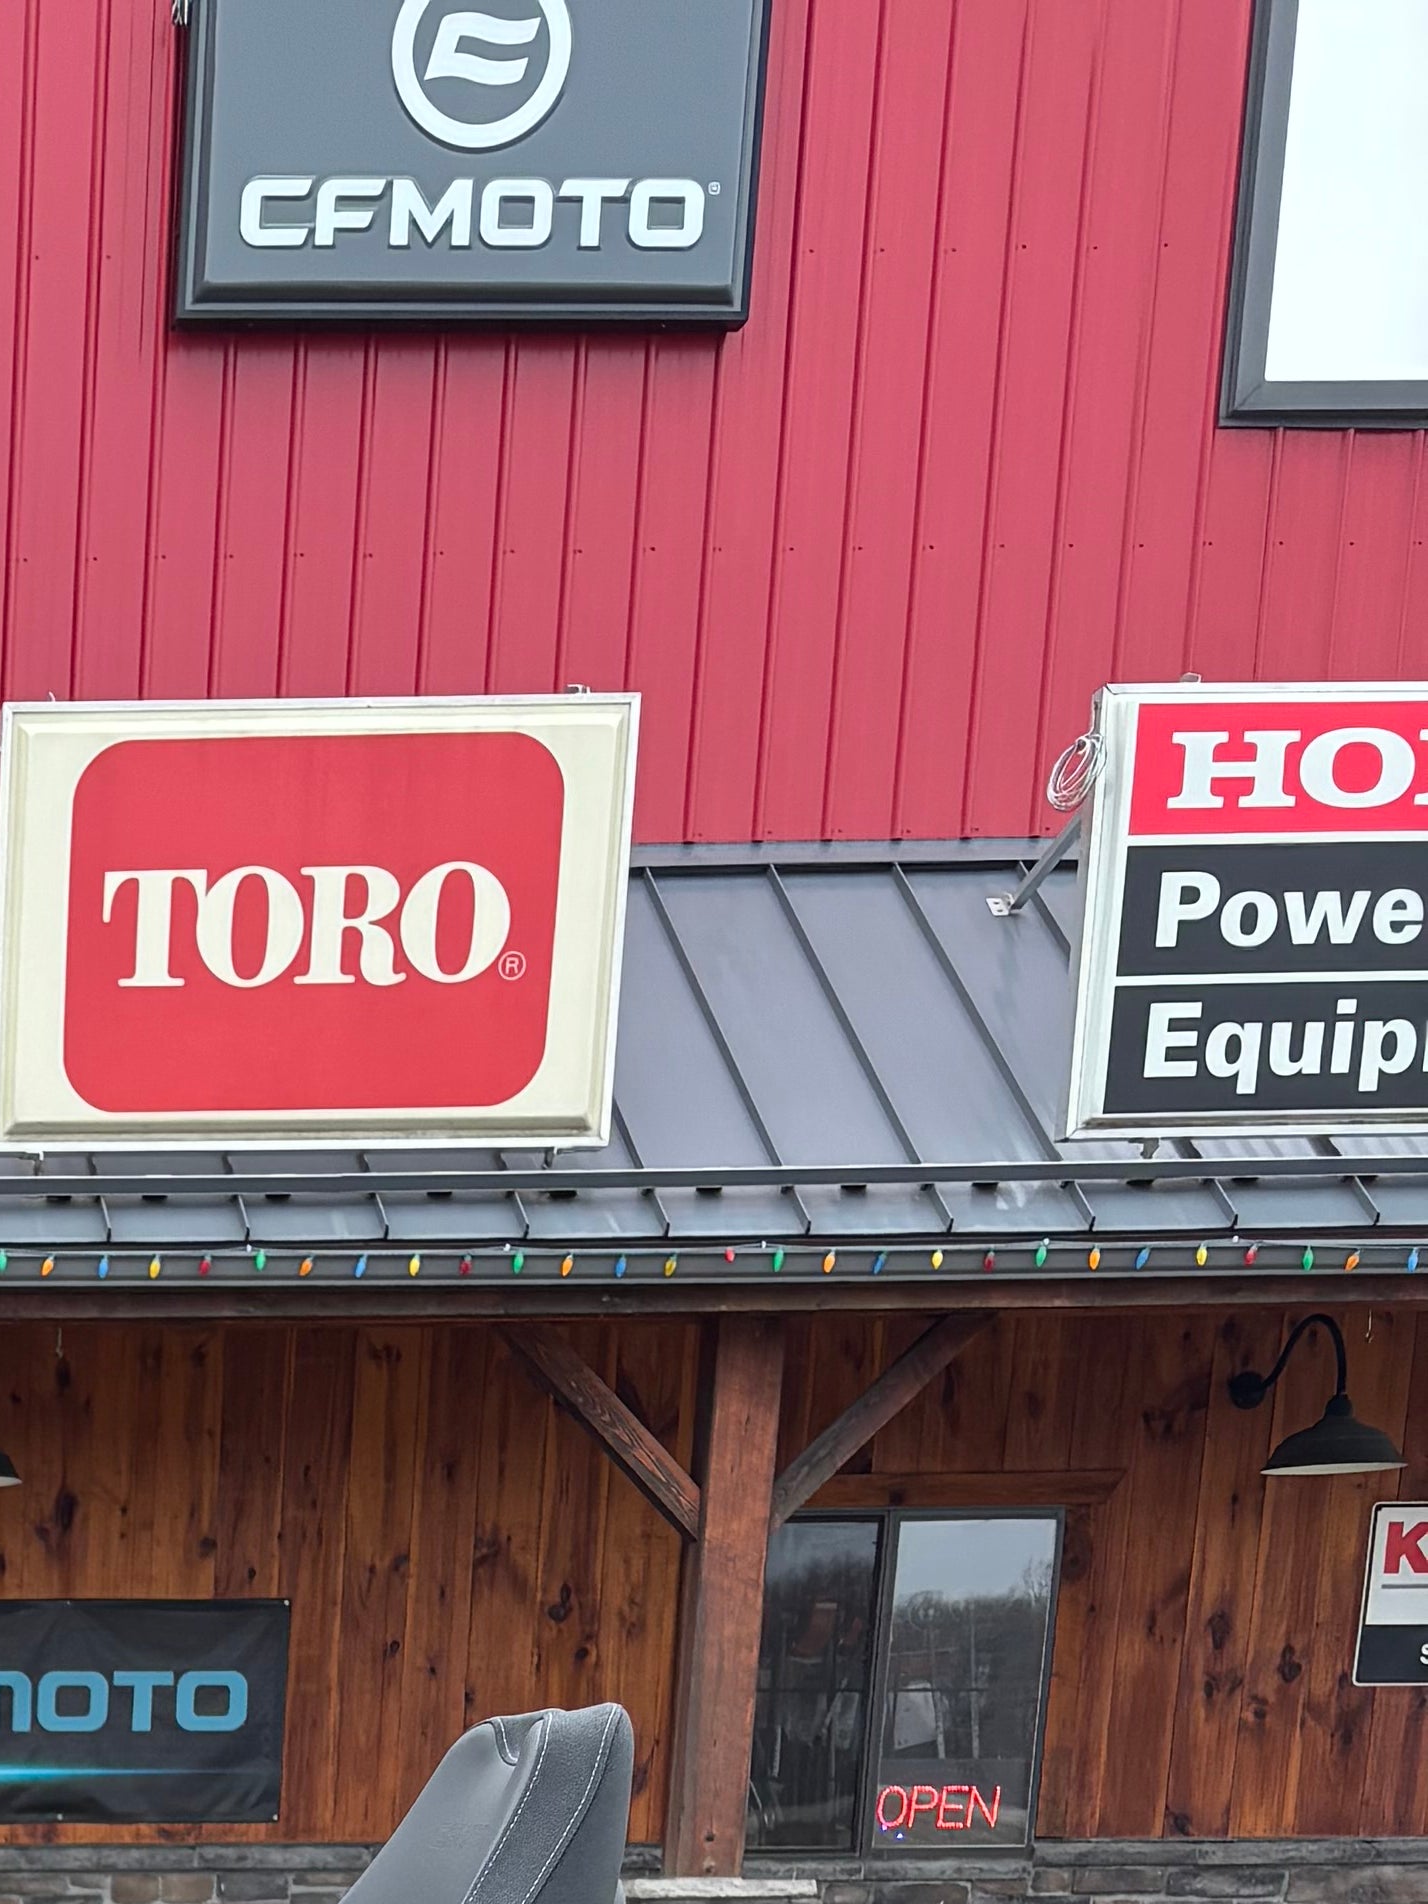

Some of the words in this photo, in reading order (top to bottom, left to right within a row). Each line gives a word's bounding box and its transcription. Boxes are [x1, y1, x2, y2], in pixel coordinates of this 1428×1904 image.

[239, 176, 705, 249] CFMOTO
[1167, 727, 1428, 809] HO
[102, 860, 512, 989] TORO
[1155, 871, 1425, 948] Powe
[1143, 999, 1428, 1095] Equip
[875, 1785, 1002, 1830] OPEN
